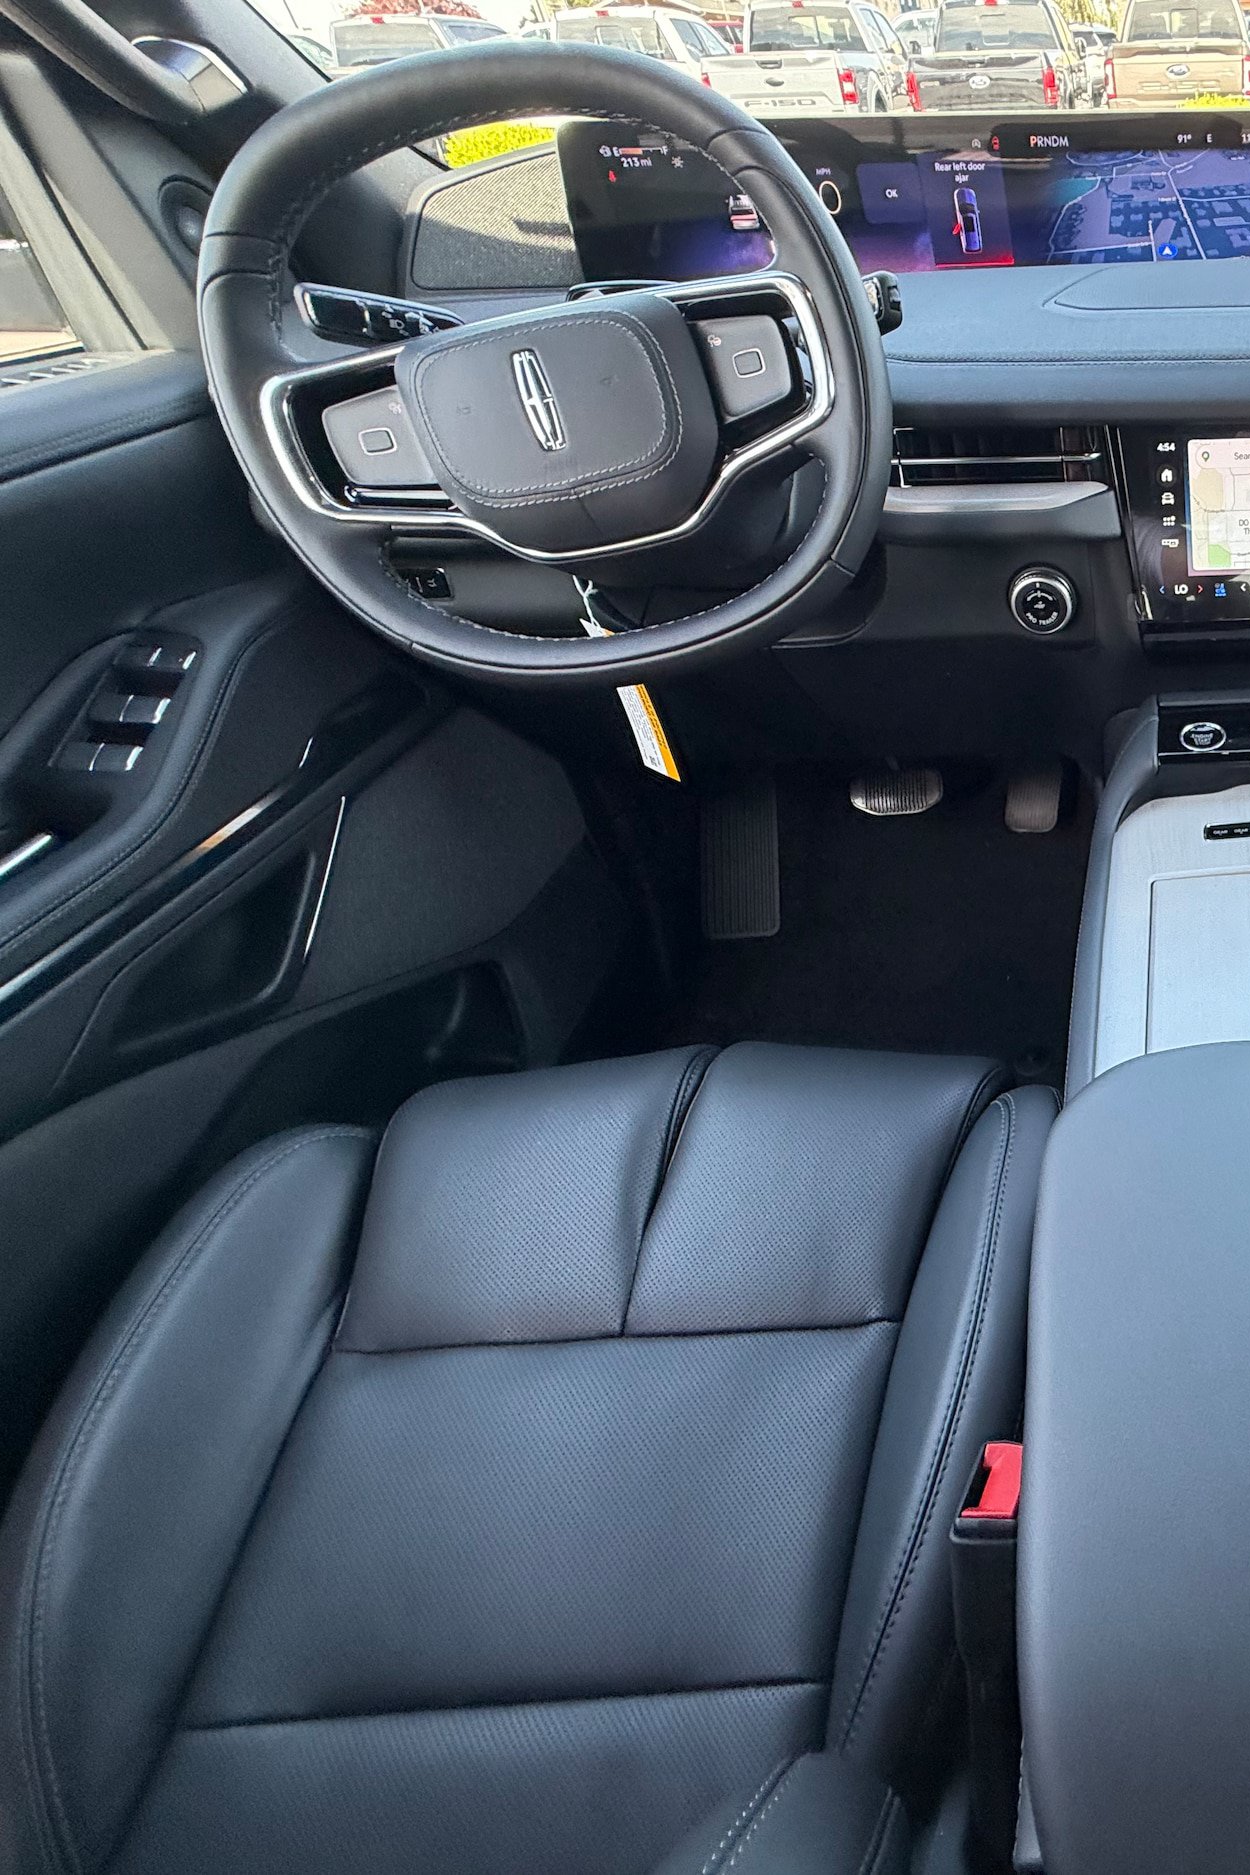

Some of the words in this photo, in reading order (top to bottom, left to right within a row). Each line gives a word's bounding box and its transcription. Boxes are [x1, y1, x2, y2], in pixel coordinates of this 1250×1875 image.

[1030, 135, 1069, 147] PRNDM
[621, 157, 640, 168] 213
[640, 157, 653, 167] mi
[934, 162, 952, 172] Rear
[953, 162, 965, 172] left
[966, 162, 986, 172] door
[954, 173, 969, 184] ajar
[885, 188, 898, 199] OK
[1239, 519, 1249, 527] DO
[1174, 584, 1188, 595] LO
